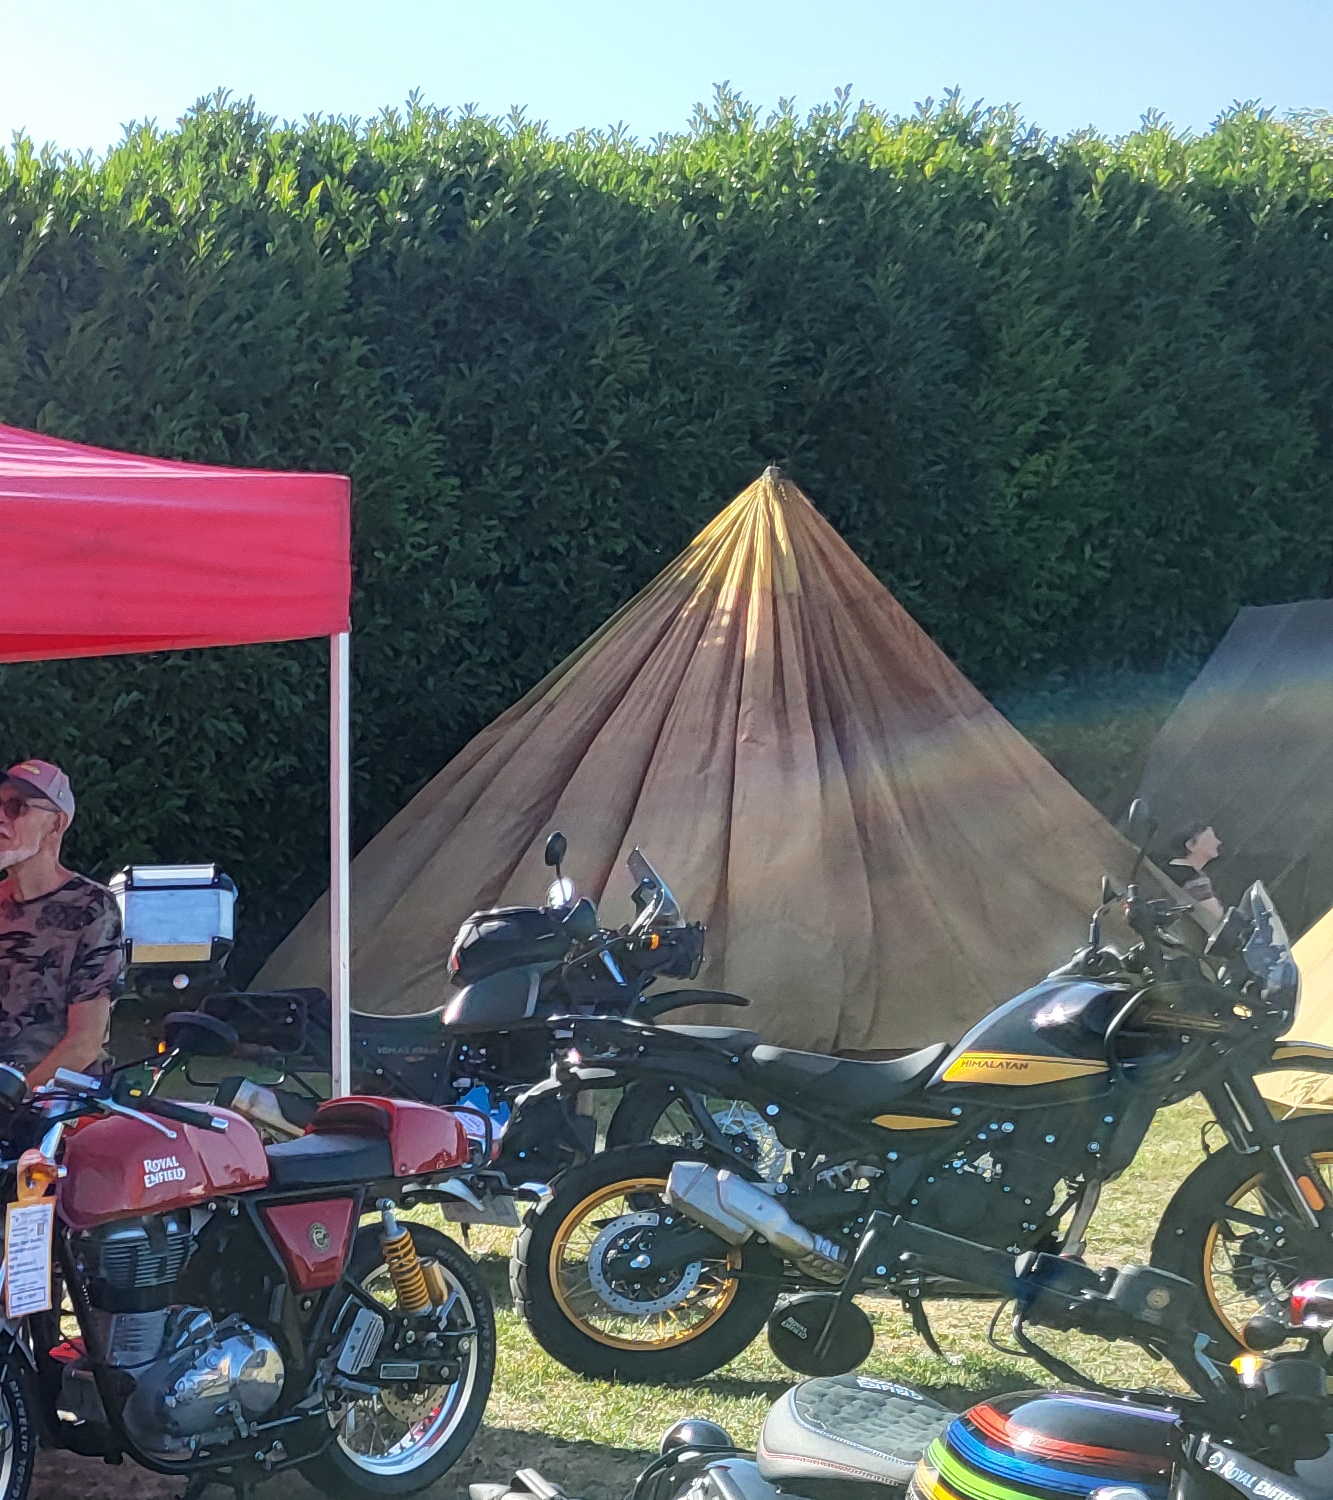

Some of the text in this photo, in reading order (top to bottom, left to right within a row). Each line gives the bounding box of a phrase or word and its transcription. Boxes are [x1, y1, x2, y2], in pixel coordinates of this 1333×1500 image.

[960, 1059, 1029, 1071] HIMALAYAN
[143, 1155, 180, 1173] ROYAL
[144, 1167, 186, 1188] ENFIELD
[1219, 1460, 1258, 1489] ROYAL
